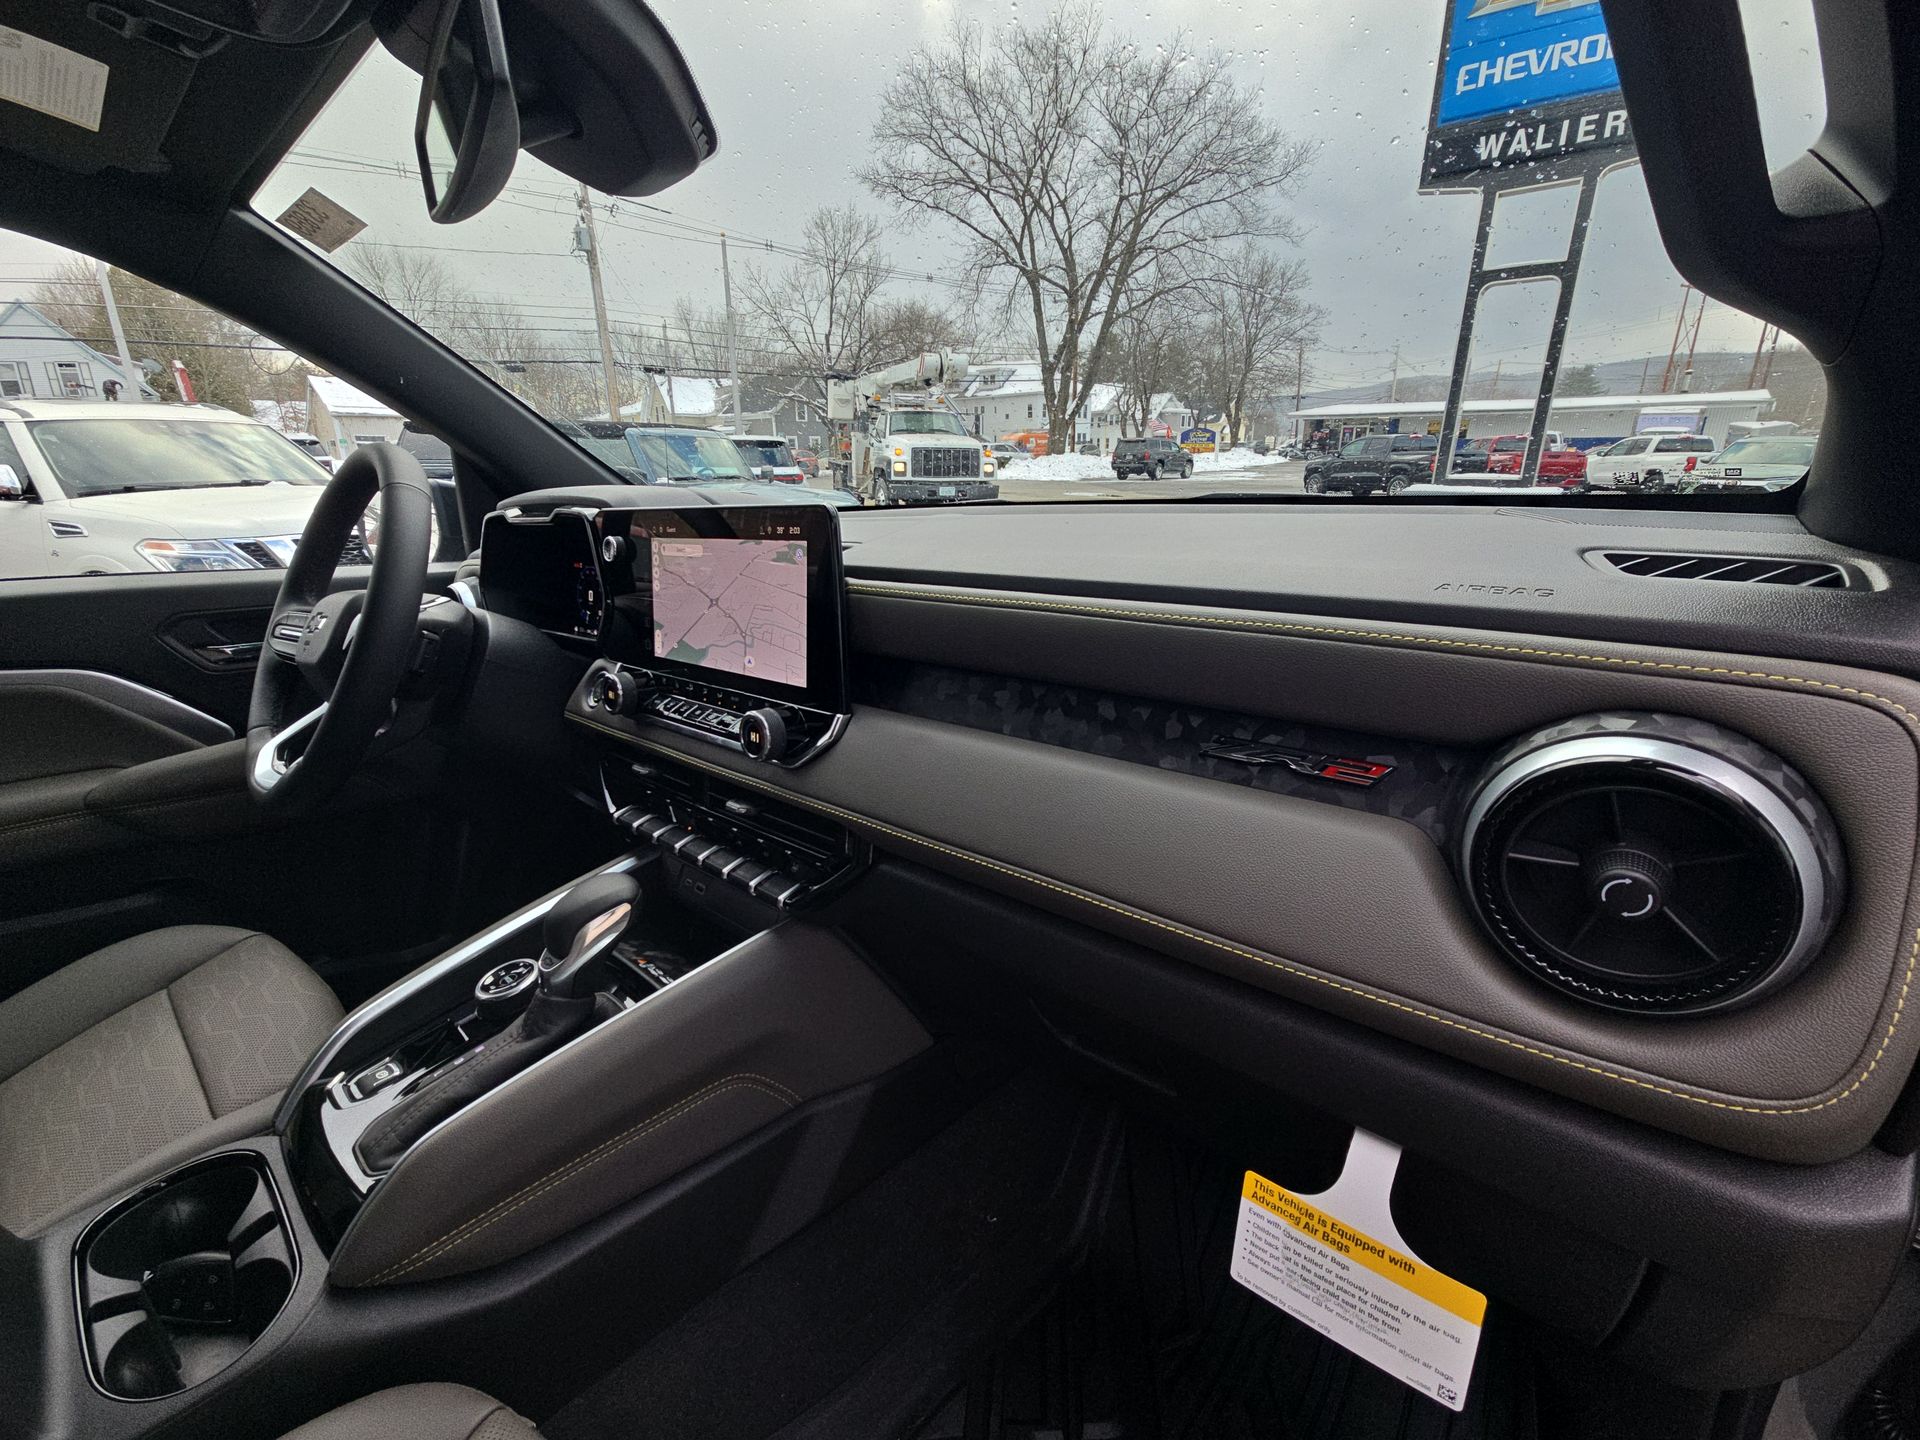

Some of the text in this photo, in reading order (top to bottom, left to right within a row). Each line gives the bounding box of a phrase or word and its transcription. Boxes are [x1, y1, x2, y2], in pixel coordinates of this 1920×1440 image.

[1475, 109, 1628, 161] WALIER
[1434, 583, 1555, 598] AIRBAG
[1248, 1207, 1264, 1220] Even
[1266, 1217, 1281, 1229] with
[1318, 1249, 1328, 1259] Air
[1330, 1256, 1349, 1272] Bags
[1248, 1250, 1270, 1266] Always
[1254, 1180, 1415, 1274] This Vehicle is Equipped with
[1303, 1221, 1319, 1236] Air
[1321, 1231, 1350, 1254] Bags
[1250, 1241, 1267, 1254] Never
[1269, 1253, 1279, 1262] put
[1322, 1287, 1339, 1299] child
[1341, 1297, 1356, 1309] seat
[1367, 1312, 1379, 1321] the
[1381, 1319, 1401, 1334] front.
[1251, 1231, 1261, 1240] The
[1264, 1239, 1279, 1250] back
[1301, 1264, 1311, 1273] the
[1313, 1271, 1334, 1286] safest
[1336, 1284, 1355, 1299] place
[1358, 1296, 1367, 1304] for
[1370, 1302, 1402, 1324] children.
[1252, 1223, 1279, 1240] Children
[1293, 1249, 1301, 1257] be
[1303, 1255, 1322, 1269] killed
[1334, 1273, 1368, 1296] seriously
[1371, 1292, 1398, 1312] injured
[1400, 1309, 1411, 1318] by
[1413, 1315, 1426, 1325] the
[1428, 1323, 1440, 1333] air
[1286, 1282, 1309, 1299] manual
[1324, 1304, 1333, 1312] for
[1335, 1311, 1353, 1324] more
[1422, 1360, 1432, 1369] air
